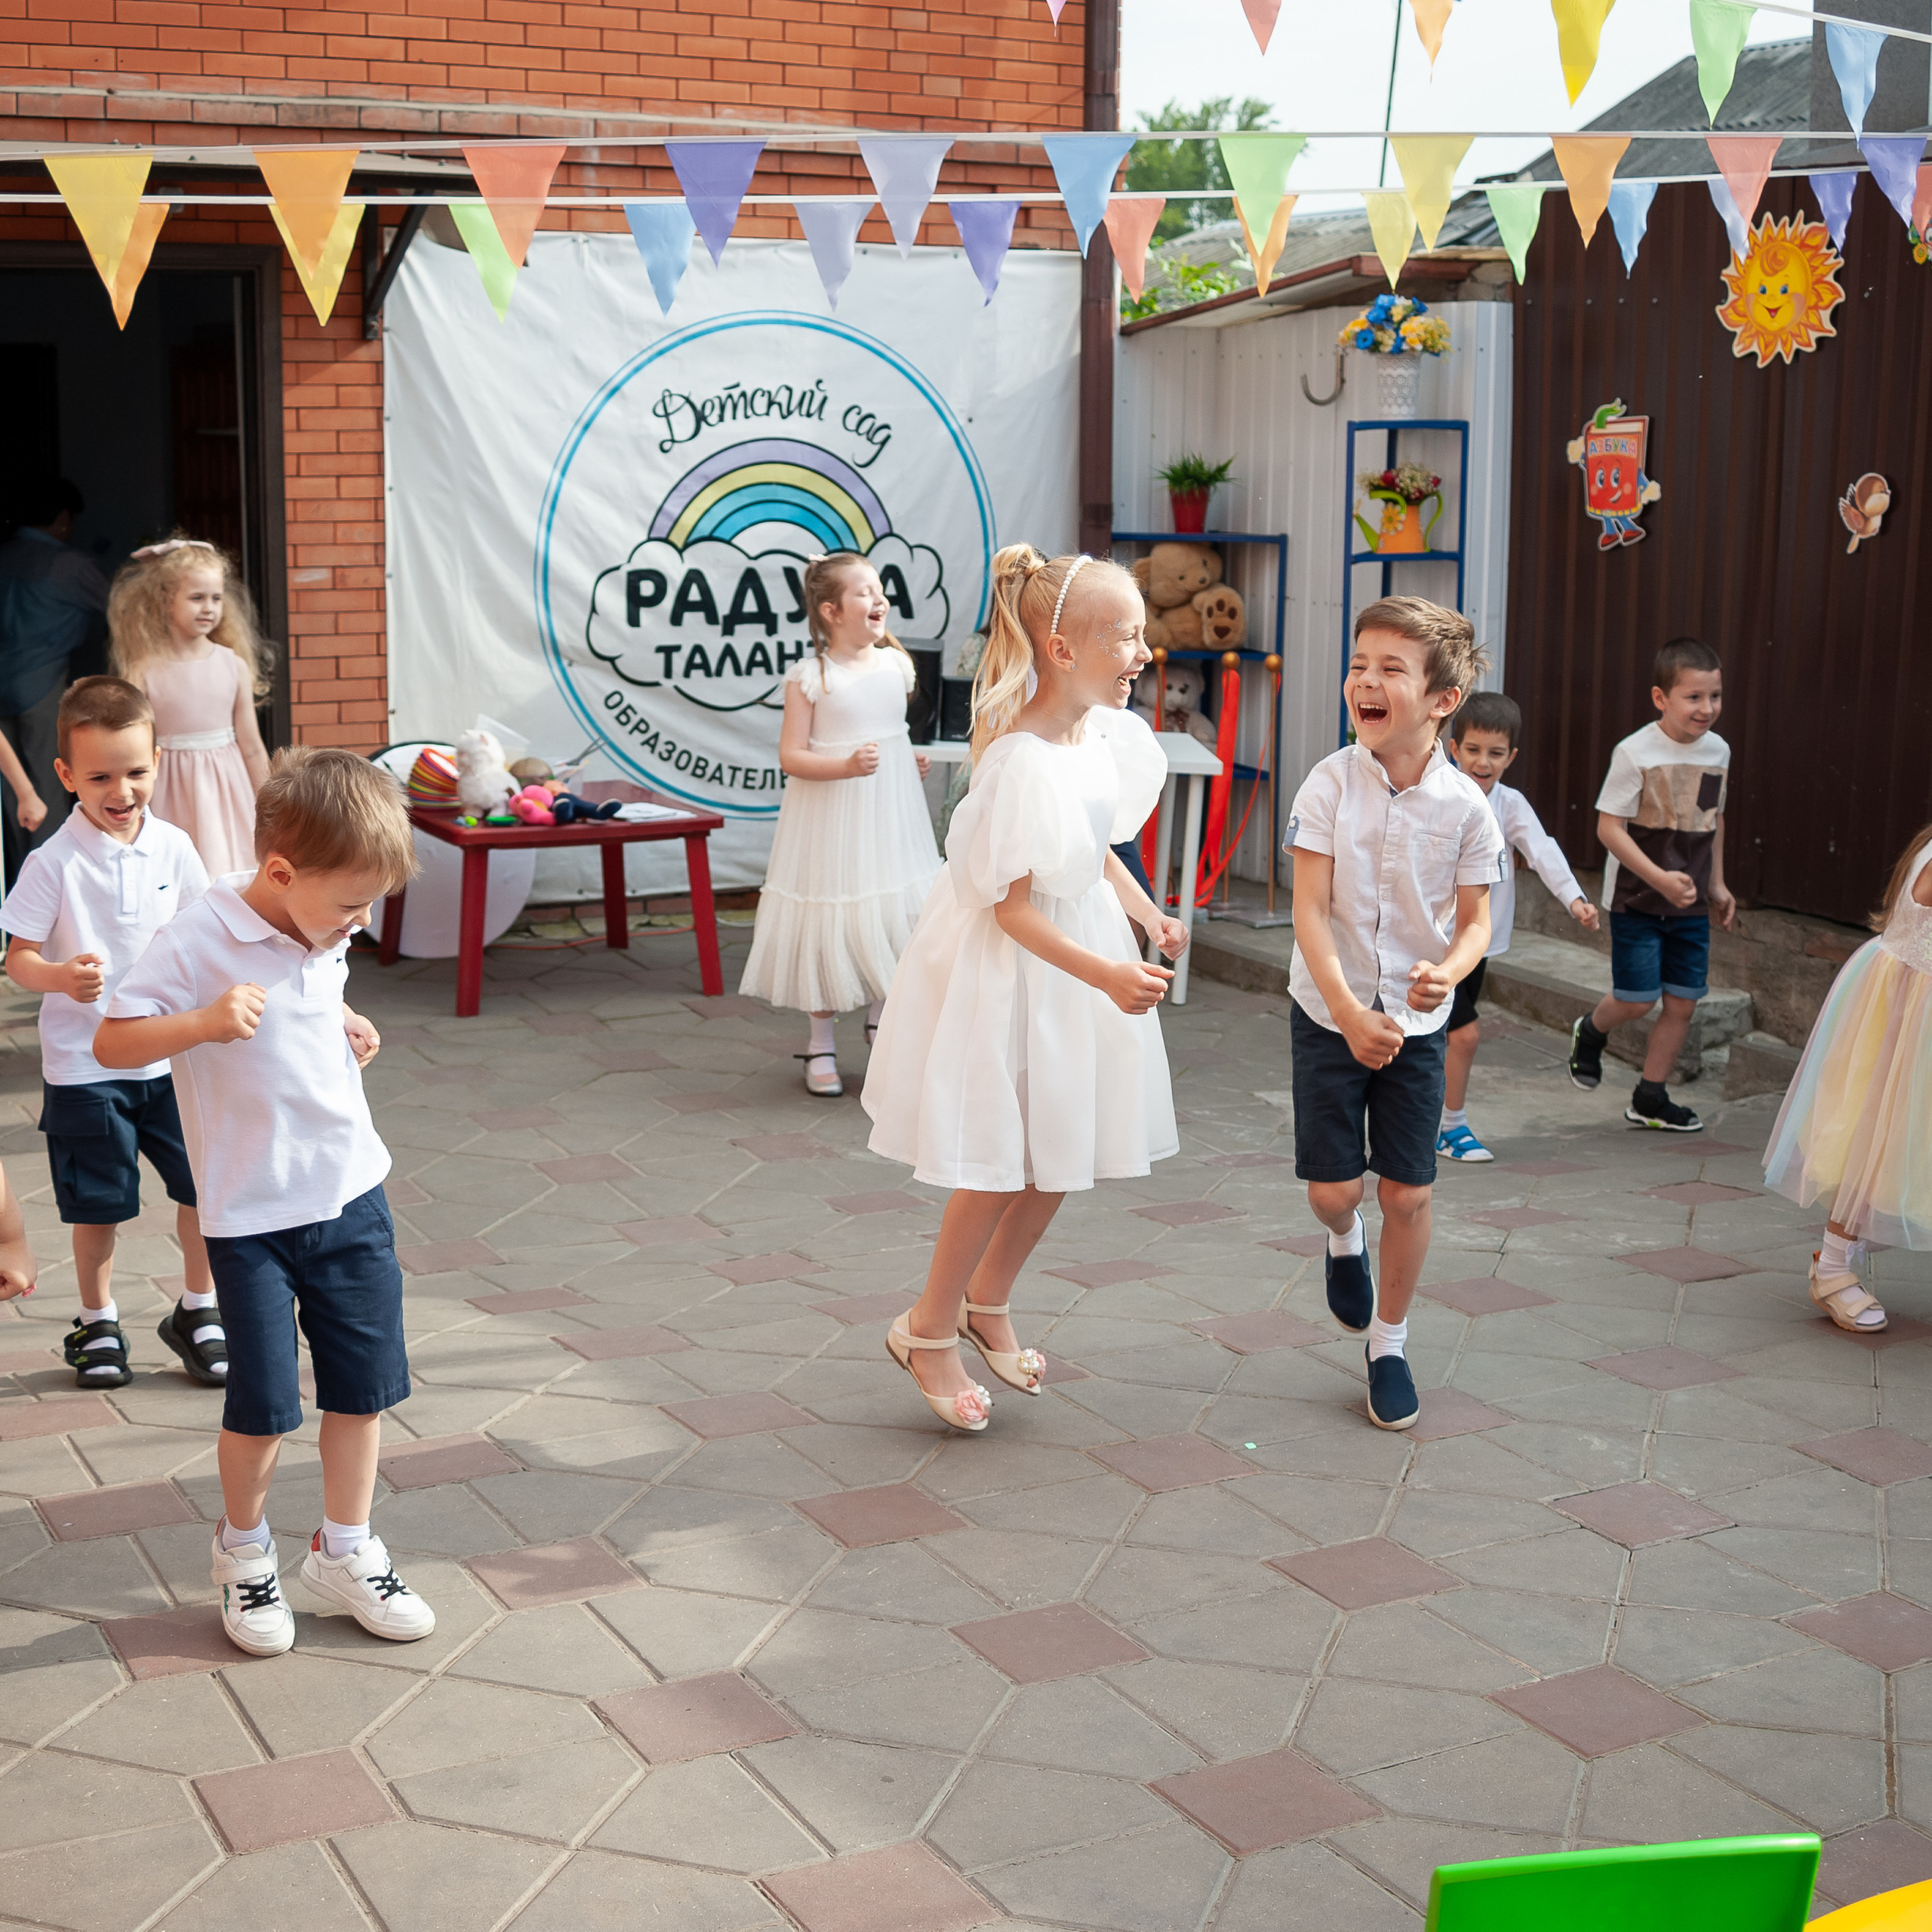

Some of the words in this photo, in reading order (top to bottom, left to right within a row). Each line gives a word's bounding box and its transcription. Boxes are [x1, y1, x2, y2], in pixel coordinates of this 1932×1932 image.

[652, 379, 828, 454] Детский
[841, 405, 891, 468] сад
[1589, 438, 1636, 456] АЗБУКА
[626, 564, 914, 637] РАДУА
[654, 640, 829, 679] ТАЛАН
[604, 690, 789, 790] ОБРАЗОВАТЕЛЬ
